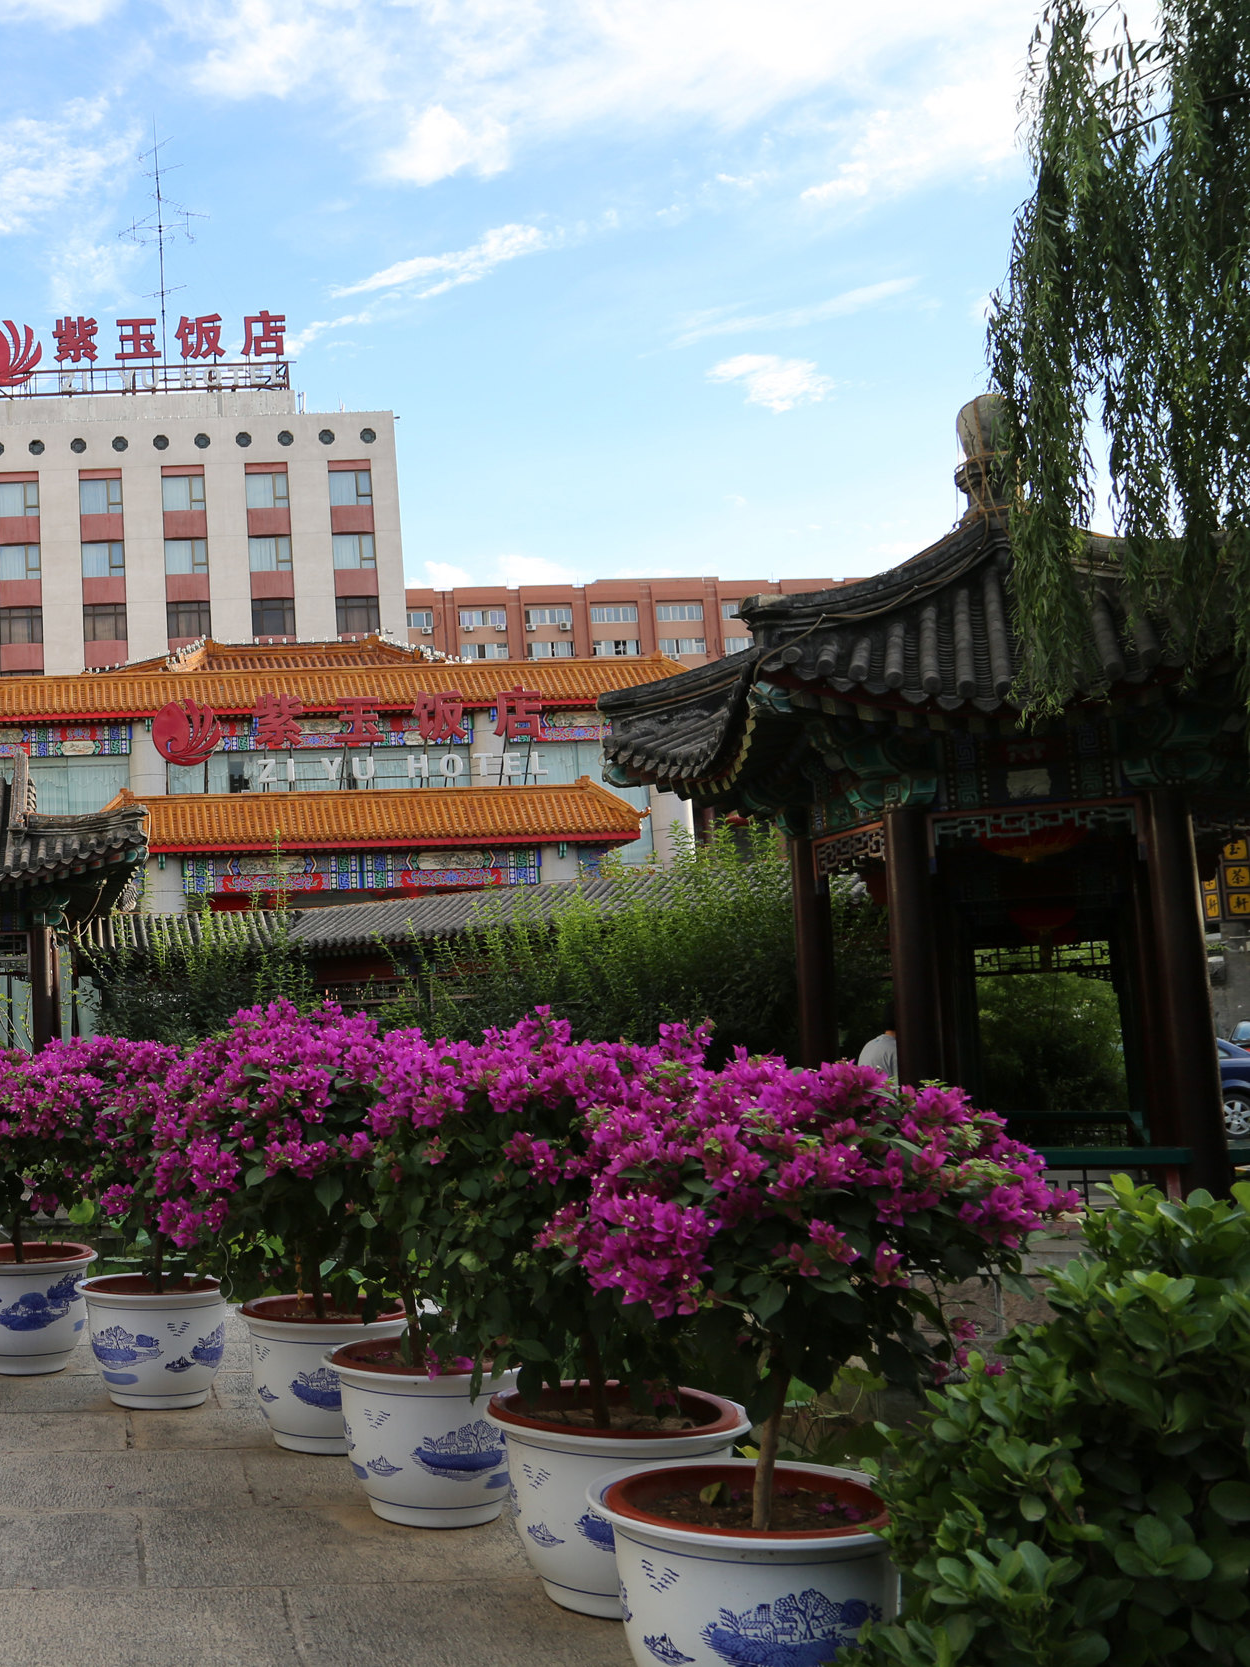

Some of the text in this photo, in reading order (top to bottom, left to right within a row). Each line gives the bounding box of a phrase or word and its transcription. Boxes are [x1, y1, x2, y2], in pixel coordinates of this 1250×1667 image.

[52, 310, 286, 363] 紫玉饭店
[61, 363, 287, 392] ZI YU HOTEL
[255, 685, 543, 746] 紫玉饭店
[257, 751, 549, 784] ZI YU HOTEL
